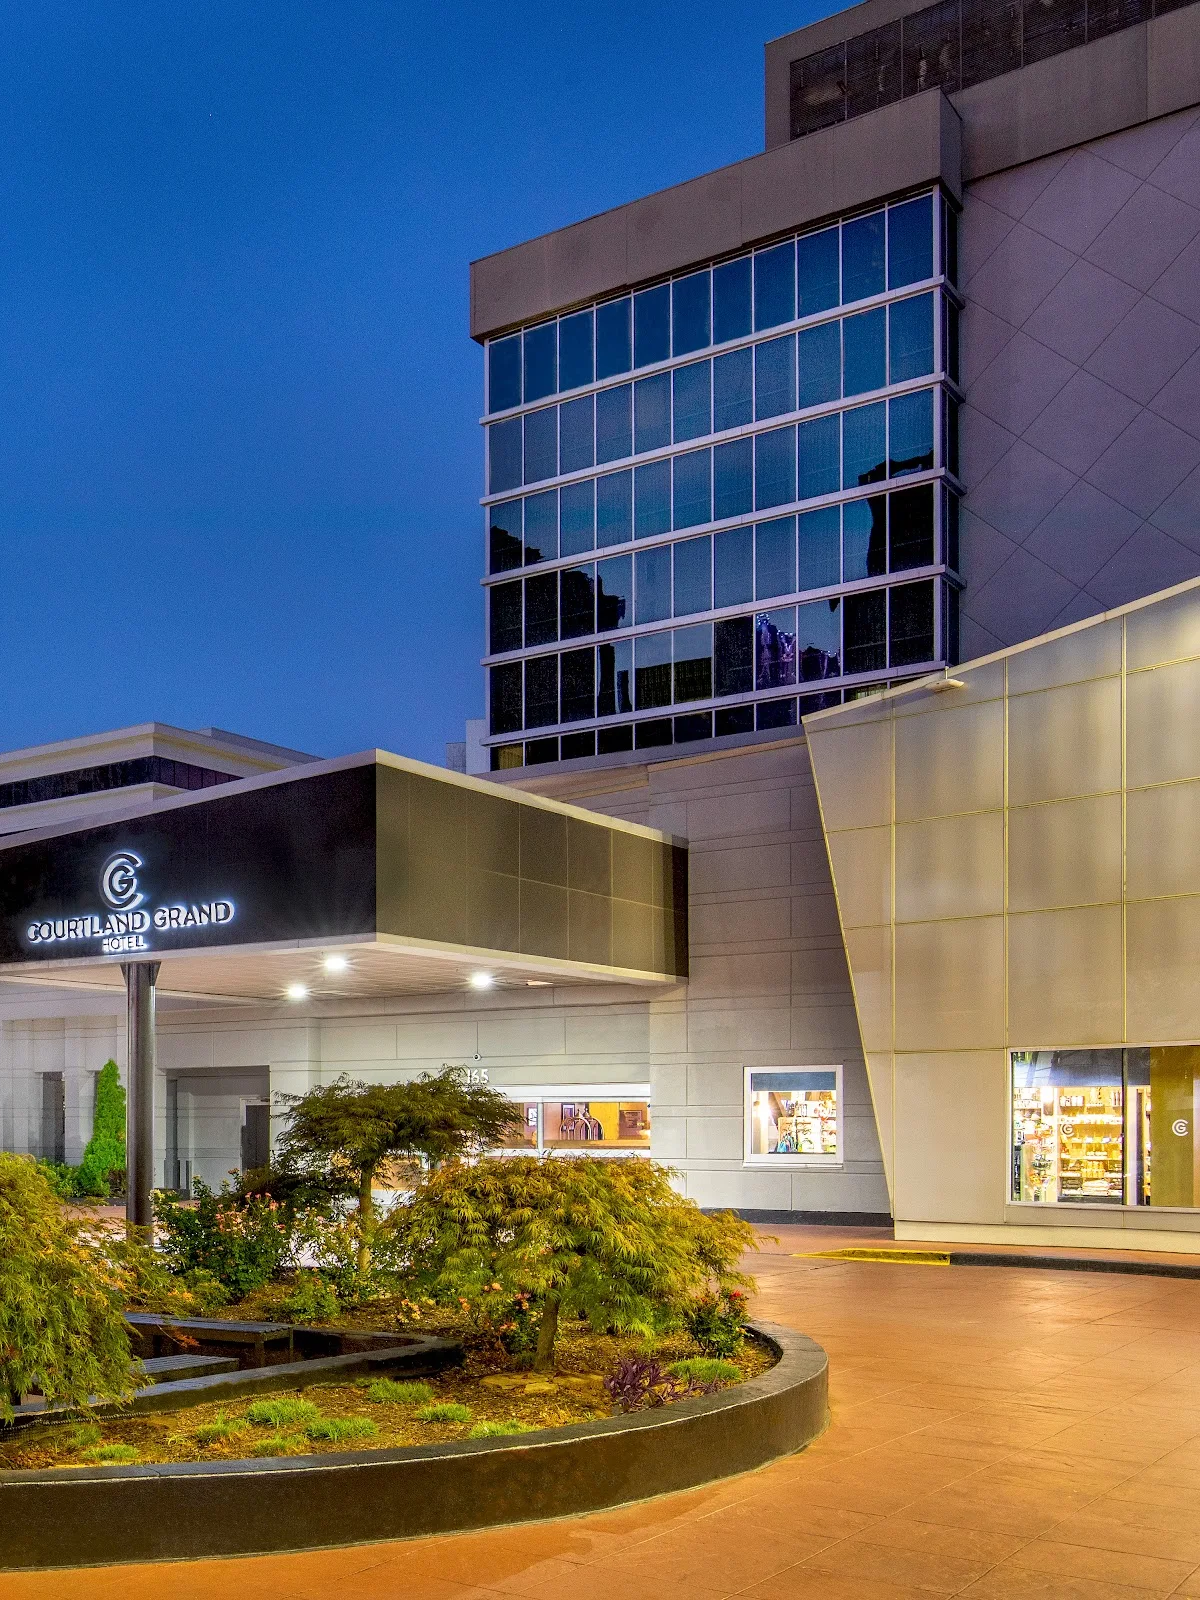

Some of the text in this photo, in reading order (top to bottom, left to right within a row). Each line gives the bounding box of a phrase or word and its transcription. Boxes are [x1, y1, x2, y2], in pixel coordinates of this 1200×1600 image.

[27, 900, 235, 943] COURTLAND GRAND
[102, 935, 147, 952] HOTEL
[467, 1068, 489, 1083] 165
